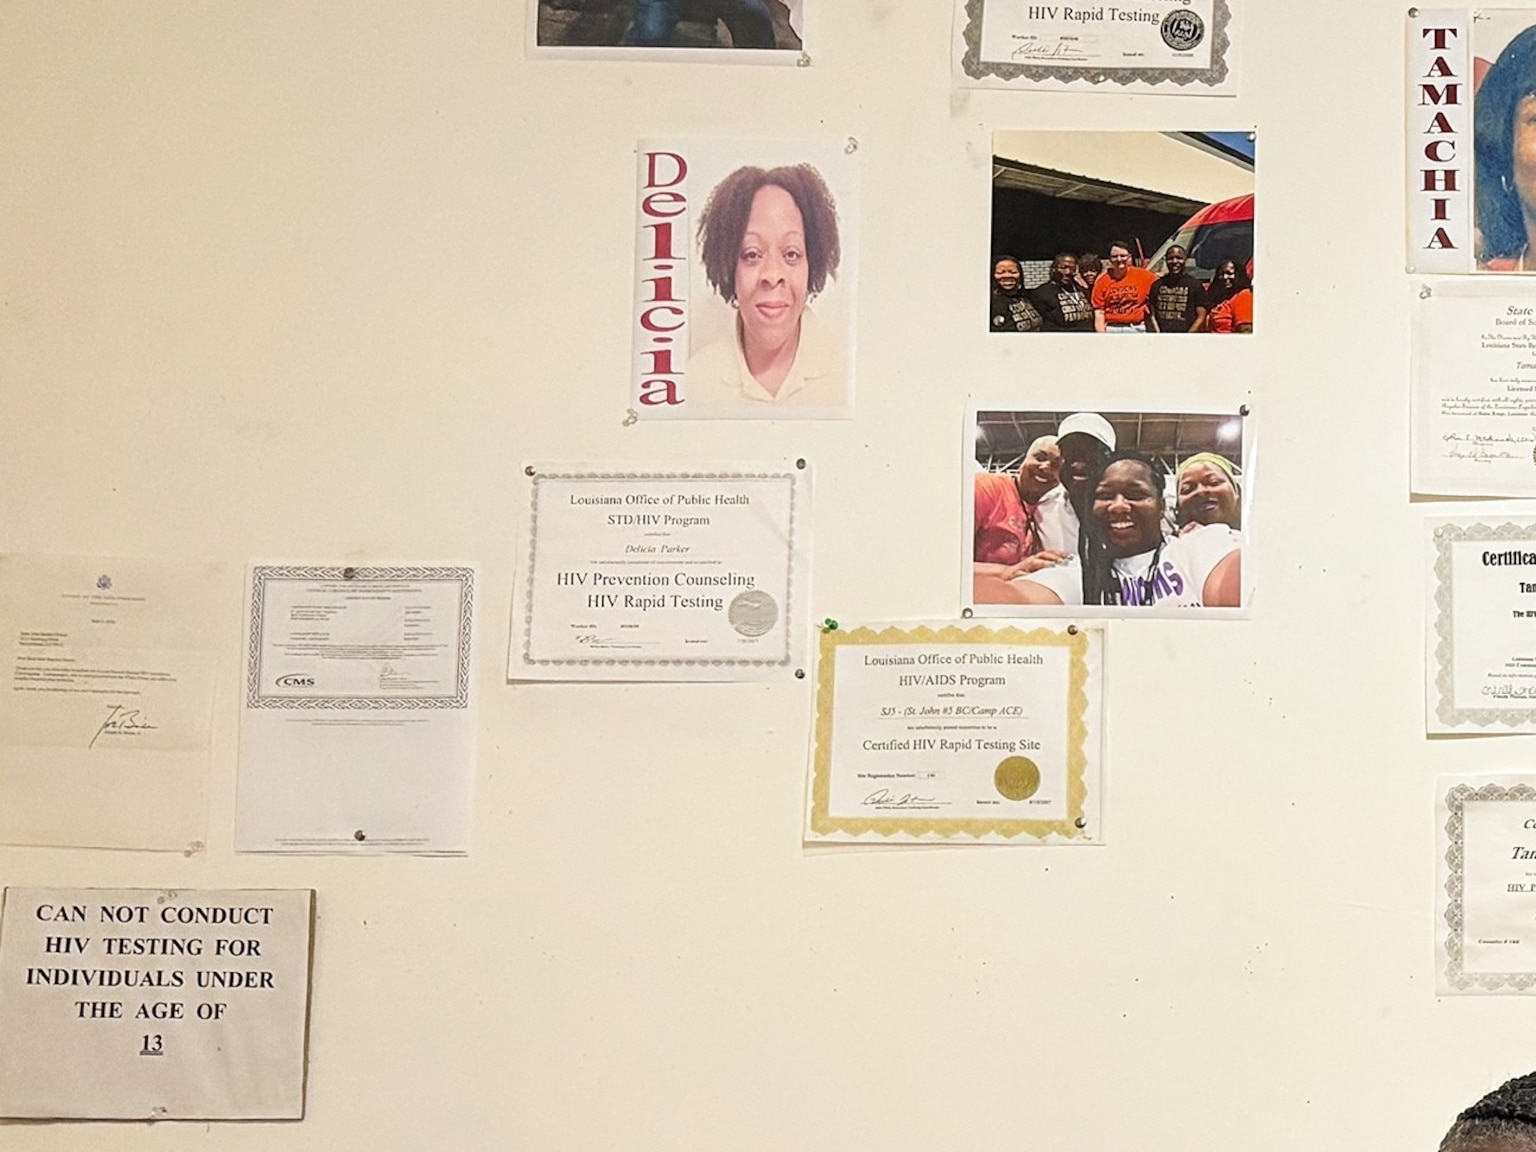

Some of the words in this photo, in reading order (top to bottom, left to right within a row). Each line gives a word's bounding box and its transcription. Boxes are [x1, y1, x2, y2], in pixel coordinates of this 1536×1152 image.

[1028, 5, 1059, 20] HIV
[1063, 6, 1104, 25] Rapid
[1108, 7, 1160, 26] Testing
[1417, 28, 1463, 250] TAMACHIA
[639, 151, 688, 406] Delicia
[1506, 305, 1534, 316] State
[1495, 317, 1517, 326] Board
[1518, 318, 1527, 326] of
[570, 494, 623, 505] Louisiana
[624, 494, 660, 505] Office
[662, 494, 676, 505] of
[677, 494, 711, 505] Public
[714, 494, 750, 505] Health
[607, 514, 661, 526] STD/HIV
[664, 514, 710, 528] Program
[624, 544, 657, 554] Delicia
[660, 544, 690, 554] Parker
[557, 572, 588, 586] HIV
[593, 572, 670, 586] Prevention
[674, 572, 755, 589] Counseling
[587, 594, 619, 608] HIV
[624, 594, 666, 612] Rapid
[669, 594, 724, 612] Testing
[864, 654, 916, 667] Louisiana
[917, 653, 952, 665] Office
[954, 652, 968, 665] of
[969, 653, 1004, 665] Public
[1007, 653, 1044, 665] Health
[284, 677, 316, 687] CMS
[899, 674, 957, 687] HIV/AIDS
[959, 674, 1006, 688] Program
[862, 738, 910, 751] Certified
[912, 738, 937, 751] HIV
[939, 738, 973, 753] Rapid
[974, 738, 1017, 753] Testing
[1018, 738, 1041, 751] Site
[1506, 883, 1526, 892] HIV
[36, 904, 87, 923] CAN
[100, 905, 150, 924] NOT
[160, 904, 274, 925] CONDUCT
[45, 936, 91, 954] HIV
[102, 937, 203, 956] TESTING
[215, 939, 261, 957] FOR
[26, 967, 184, 988] INDIVIDUALS
[196, 970, 275, 989] UNDER
[74, 1001, 123, 1019] THE
[135, 1001, 184, 1020] AGE
[196, 1002, 227, 1020] OF
[141, 1033, 163, 1051] 13
